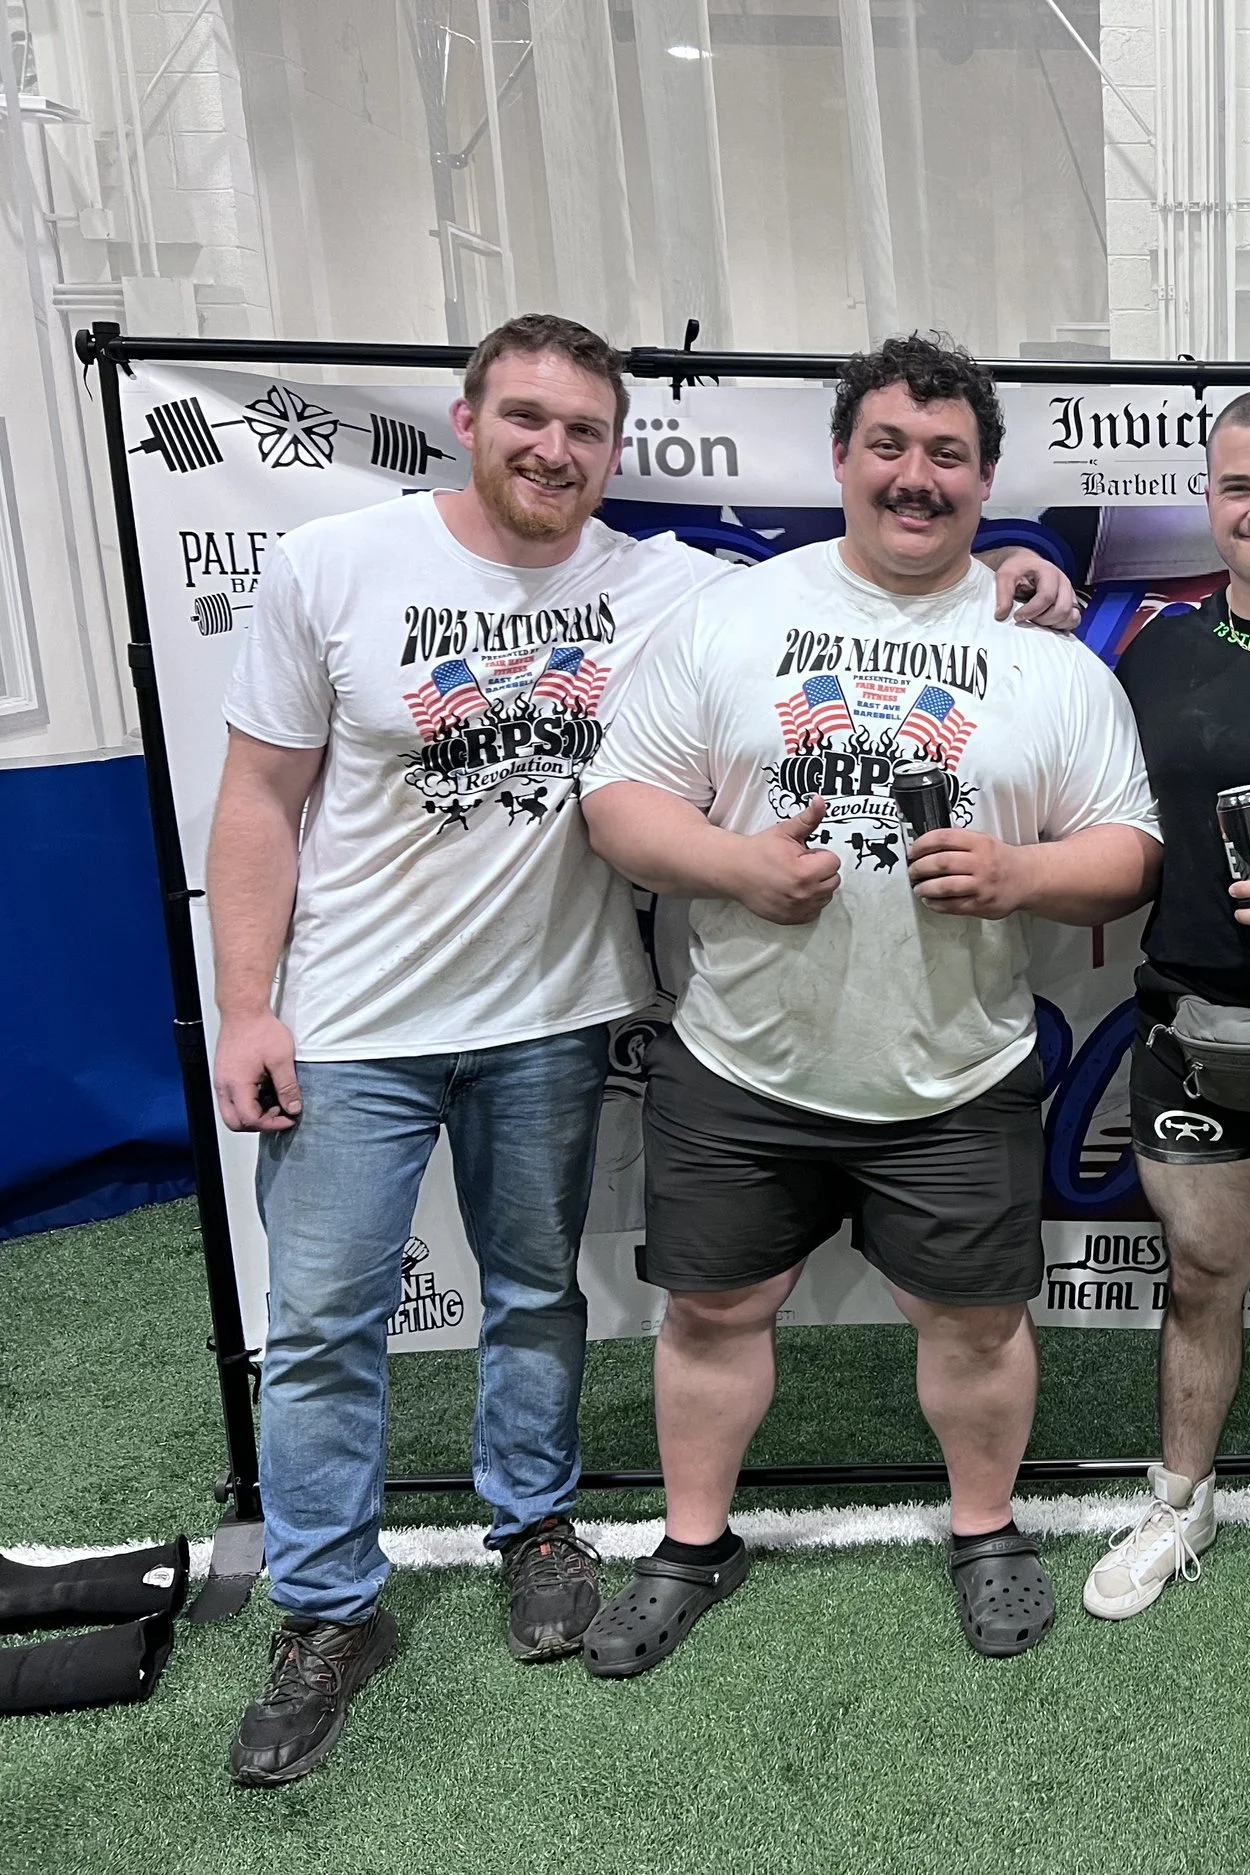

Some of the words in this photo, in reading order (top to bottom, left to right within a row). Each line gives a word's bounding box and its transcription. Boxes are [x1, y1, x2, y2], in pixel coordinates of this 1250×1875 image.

[1048, 397, 1214, 450] Invict
[1081, 472, 1177, 496] Barbell
[400, 606, 468, 666] 2025
[472, 592, 616, 653] NATIONALS
[776, 628, 844, 678] 2025
[845, 637, 988, 701] NATIONALS
[853, 674, 899, 685] PRESENTED
[857, 700, 881, 710] EAST
[882, 704, 901, 712] AVE
[462, 716, 564, 770] RPS
[465, 757, 564, 791] Revolution
[820, 752, 912, 798] RP
[386, 1289, 464, 1337] IFTING
[1047, 1281, 1139, 1310] METAL
